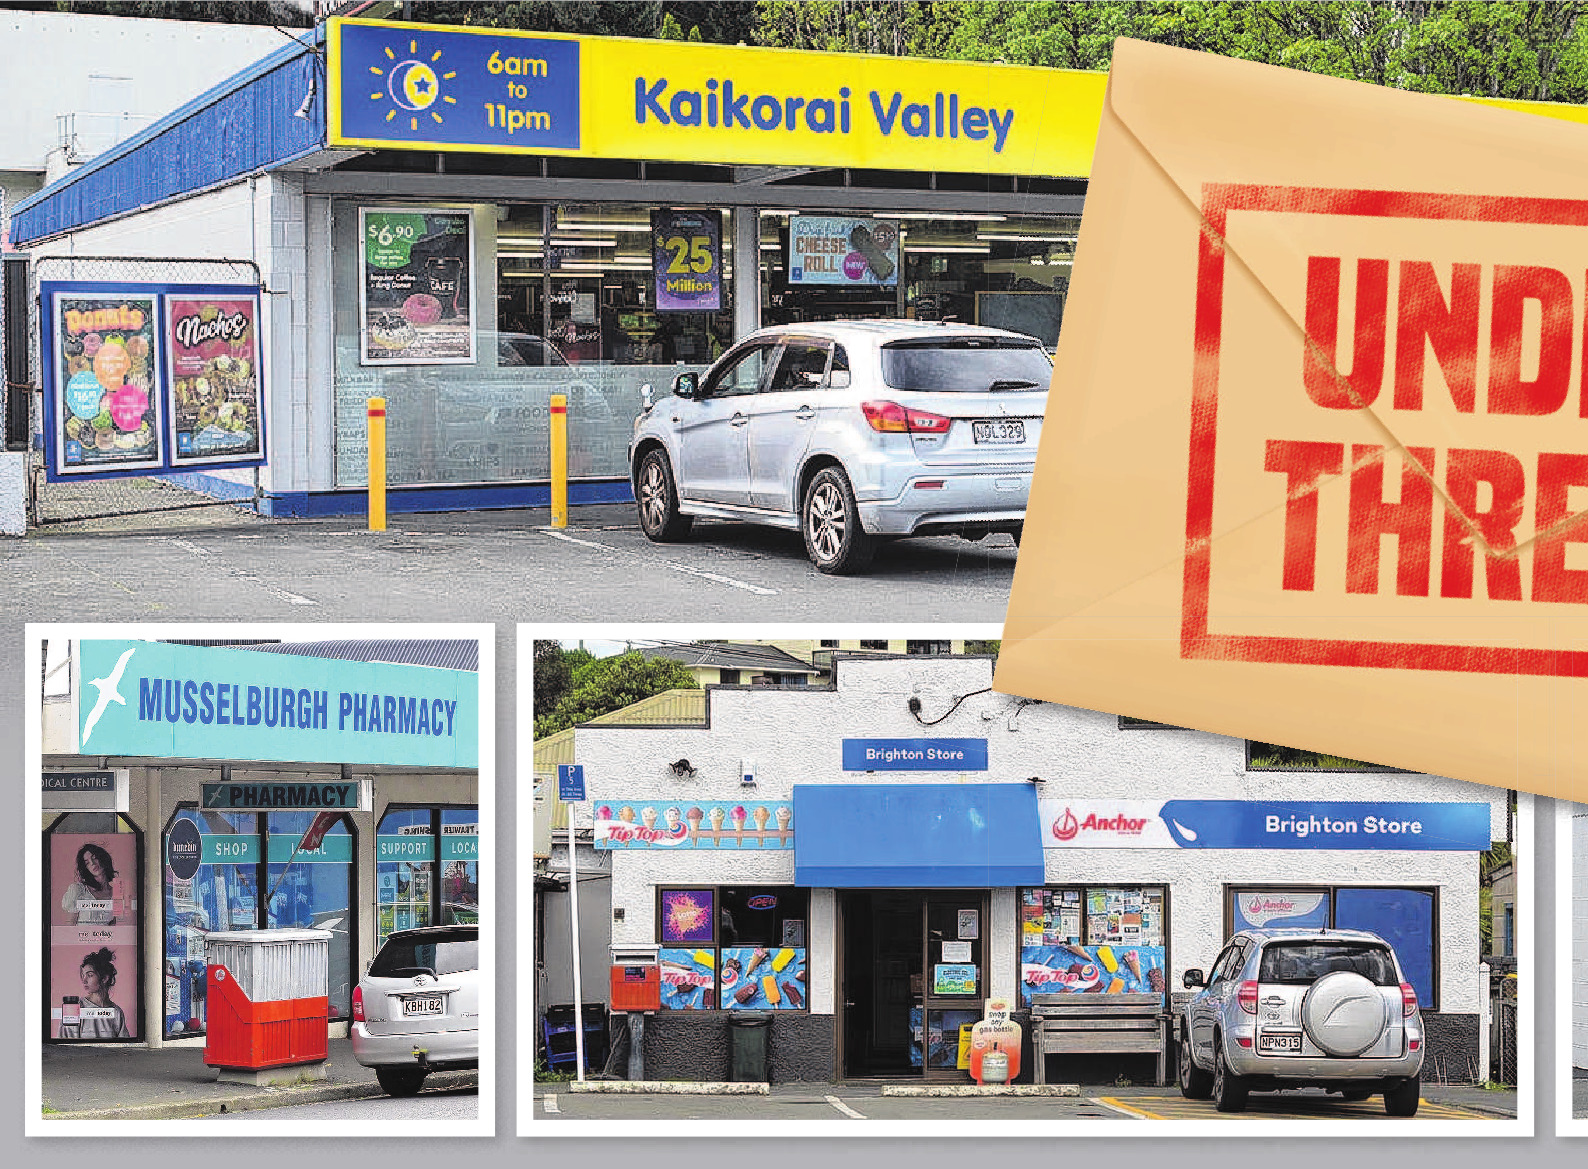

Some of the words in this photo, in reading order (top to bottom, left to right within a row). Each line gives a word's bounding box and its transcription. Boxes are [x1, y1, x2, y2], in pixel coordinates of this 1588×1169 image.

[486, 51, 548, 78] 6am
[507, 80, 528, 99] to
[484, 104, 551, 134] 11pm
[634, 76, 852, 135] Kaikorai
[869, 90, 1015, 153] Valley
[368, 224, 415, 246] $6.90
[795, 236, 847, 254] CHEESE
[803, 255, 839, 273] ROLL
[666, 279, 713, 292] Million
[176, 311, 250, 348] Nachos
[138, 677, 329, 730] MUSSELBURGH
[338, 691, 458, 738] PHARMACY
[865, 747, 925, 763] Brighton
[927, 748, 964, 761] Store
[567, 765, 576, 777] P
[70, 777, 108, 788] CENTRE
[229, 784, 350, 808] PHARMACY
[1081, 813, 1147, 831] Anchor
[1265, 815, 1358, 838] Brighton
[1363, 816, 1424, 835] Store
[606, 825, 634, 843] Tip
[634, 825, 667, 843] Top
[215, 842, 248, 856] SHOP
[381, 842, 427, 855] SUPPORT
[748, 896, 778, 908] OPEN
[1263, 899, 1295, 909] Anchor
[92, 929, 113, 939] today
[663, 972, 687, 986] Tip
[687, 972, 713, 985] Top
[1026, 970, 1050, 984] Tip
[1049, 970, 1079, 984] Top
[404, 999, 442, 1013] KBH182
[1261, 1036, 1299, 1048] NPN315
